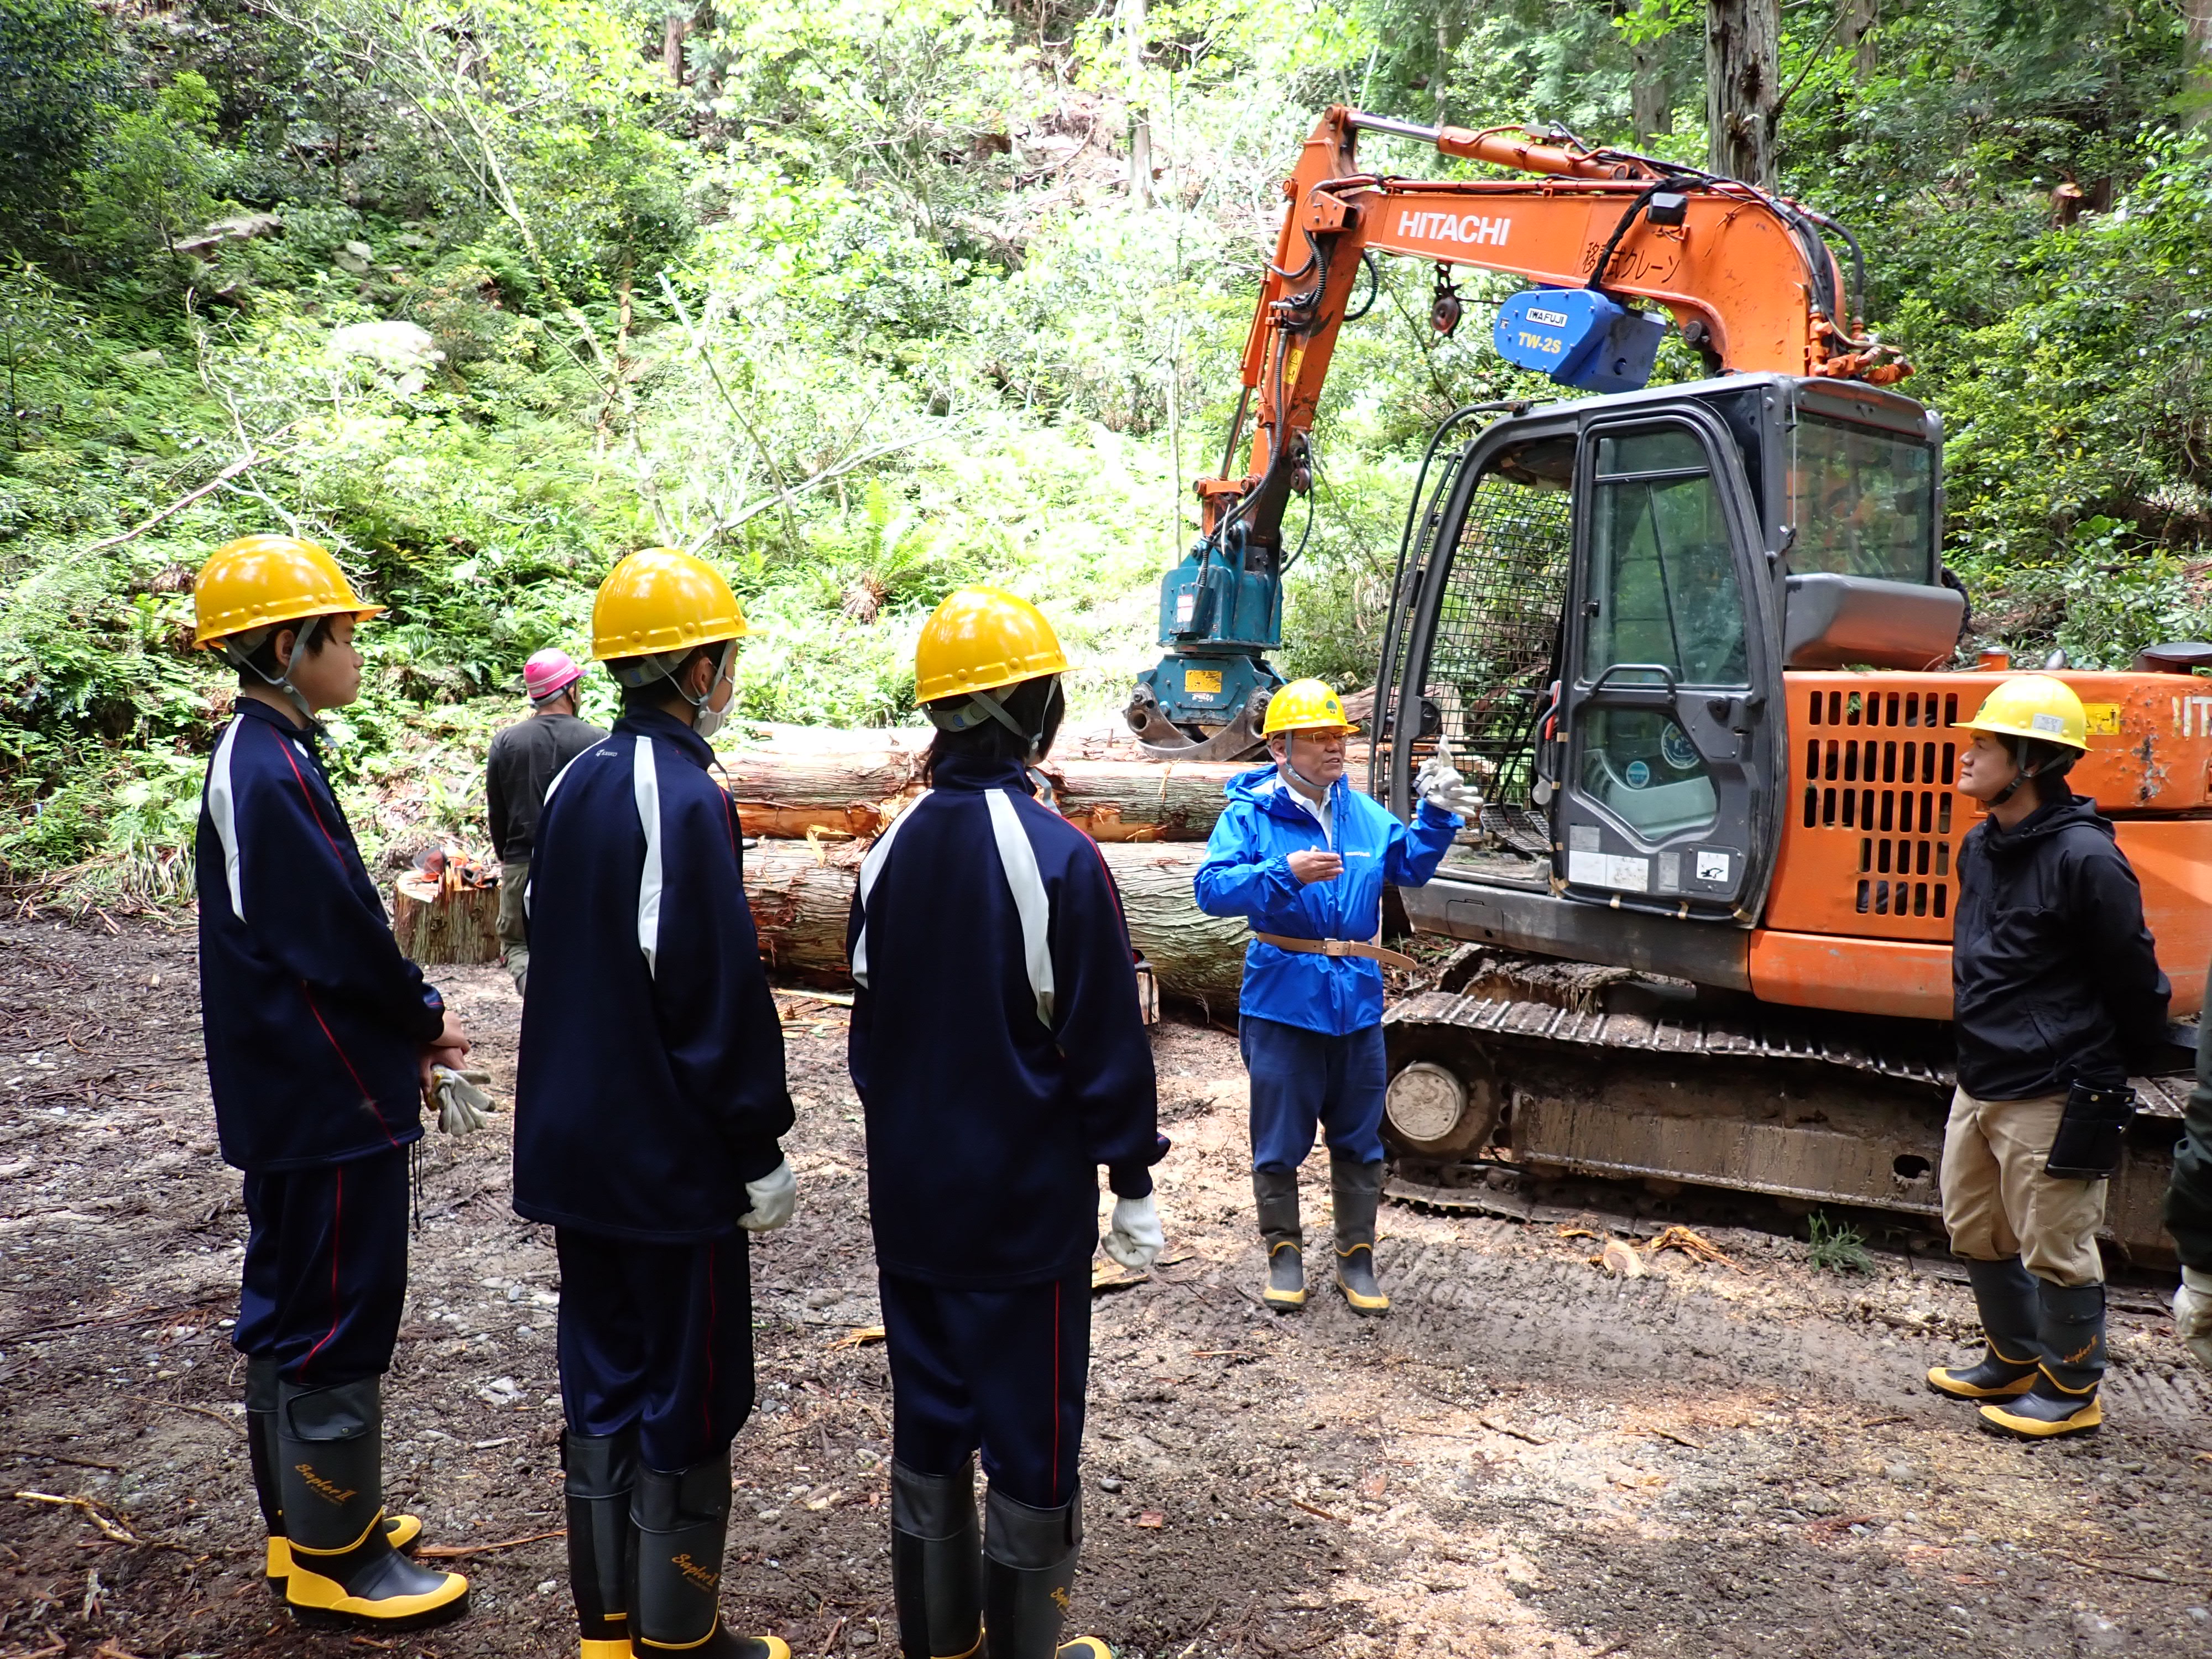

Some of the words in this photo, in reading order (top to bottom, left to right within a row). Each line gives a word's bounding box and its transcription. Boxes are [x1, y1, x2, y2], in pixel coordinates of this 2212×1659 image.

[1397, 211, 1511, 246] HITACHI
[1529, 310, 1564, 325] IWAFUJI
[1519, 332, 1562, 354] TW-2S
